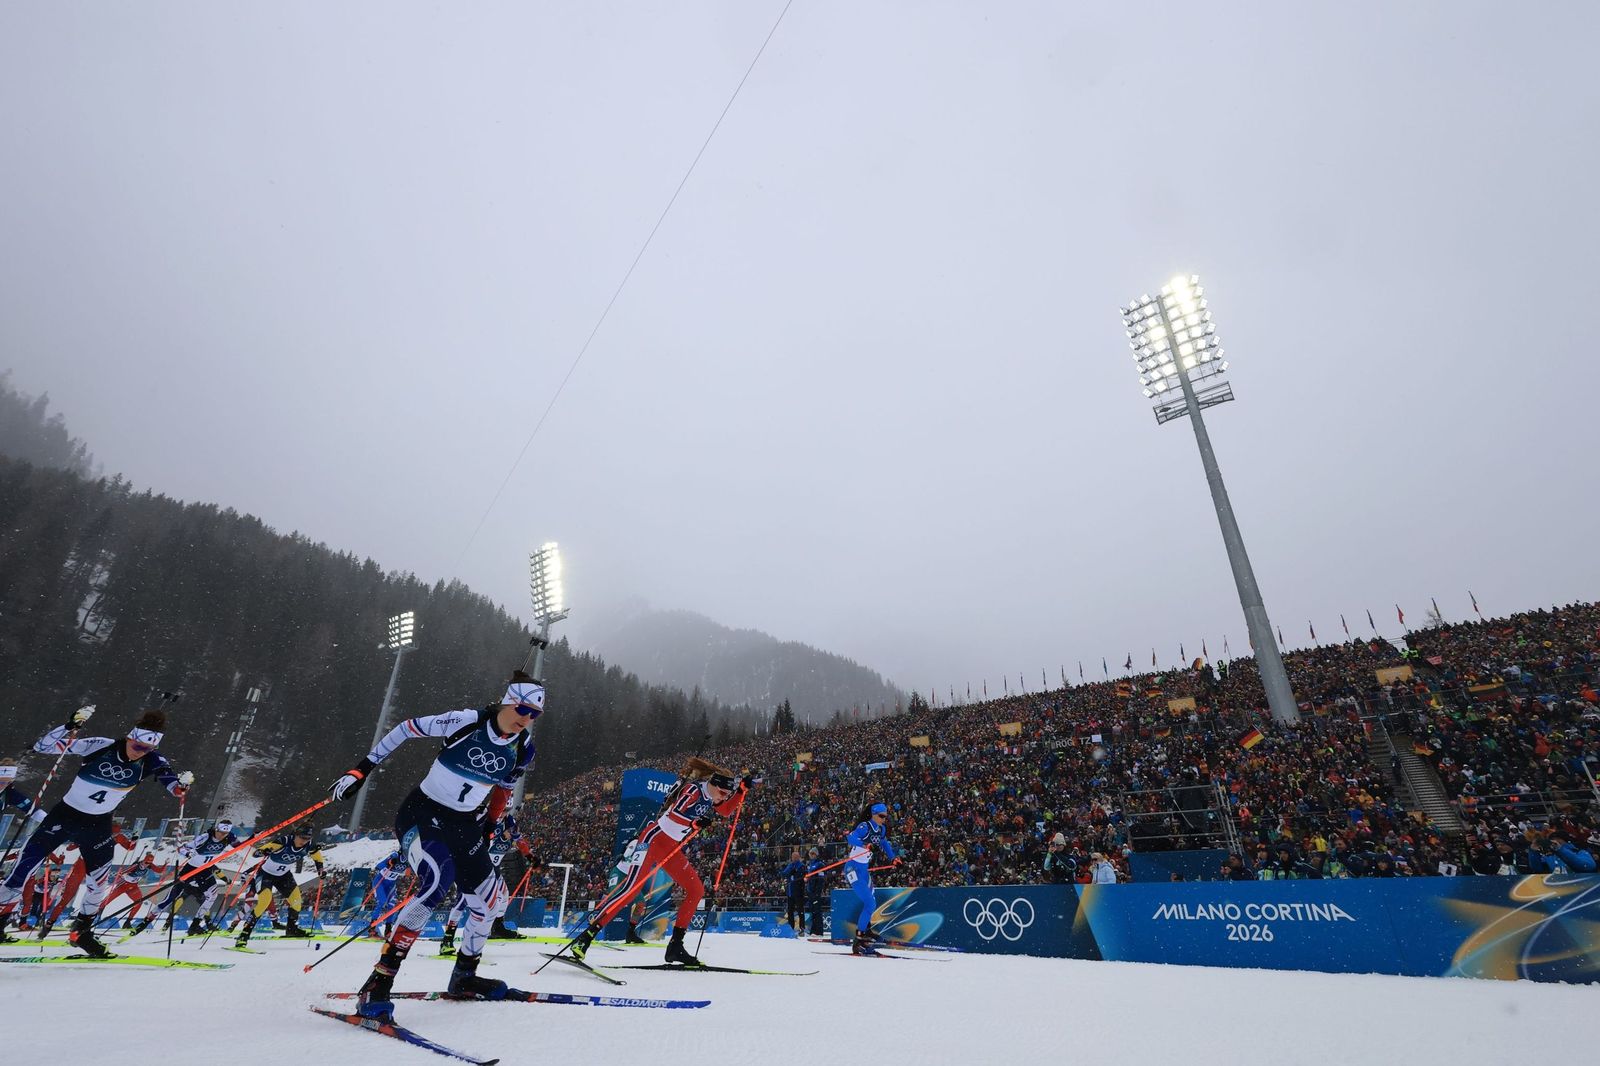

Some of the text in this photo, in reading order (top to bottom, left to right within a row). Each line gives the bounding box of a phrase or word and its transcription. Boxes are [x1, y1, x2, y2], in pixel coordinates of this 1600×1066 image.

[88, 790, 108, 804] 4
[492, 855, 500, 864] 9
[633, 853, 641, 862] 2
[1151, 903, 1357, 922] MILANO CORTINA
[1225, 923, 1275, 942] 2026
[609, 998, 669, 1008] SALOMON
